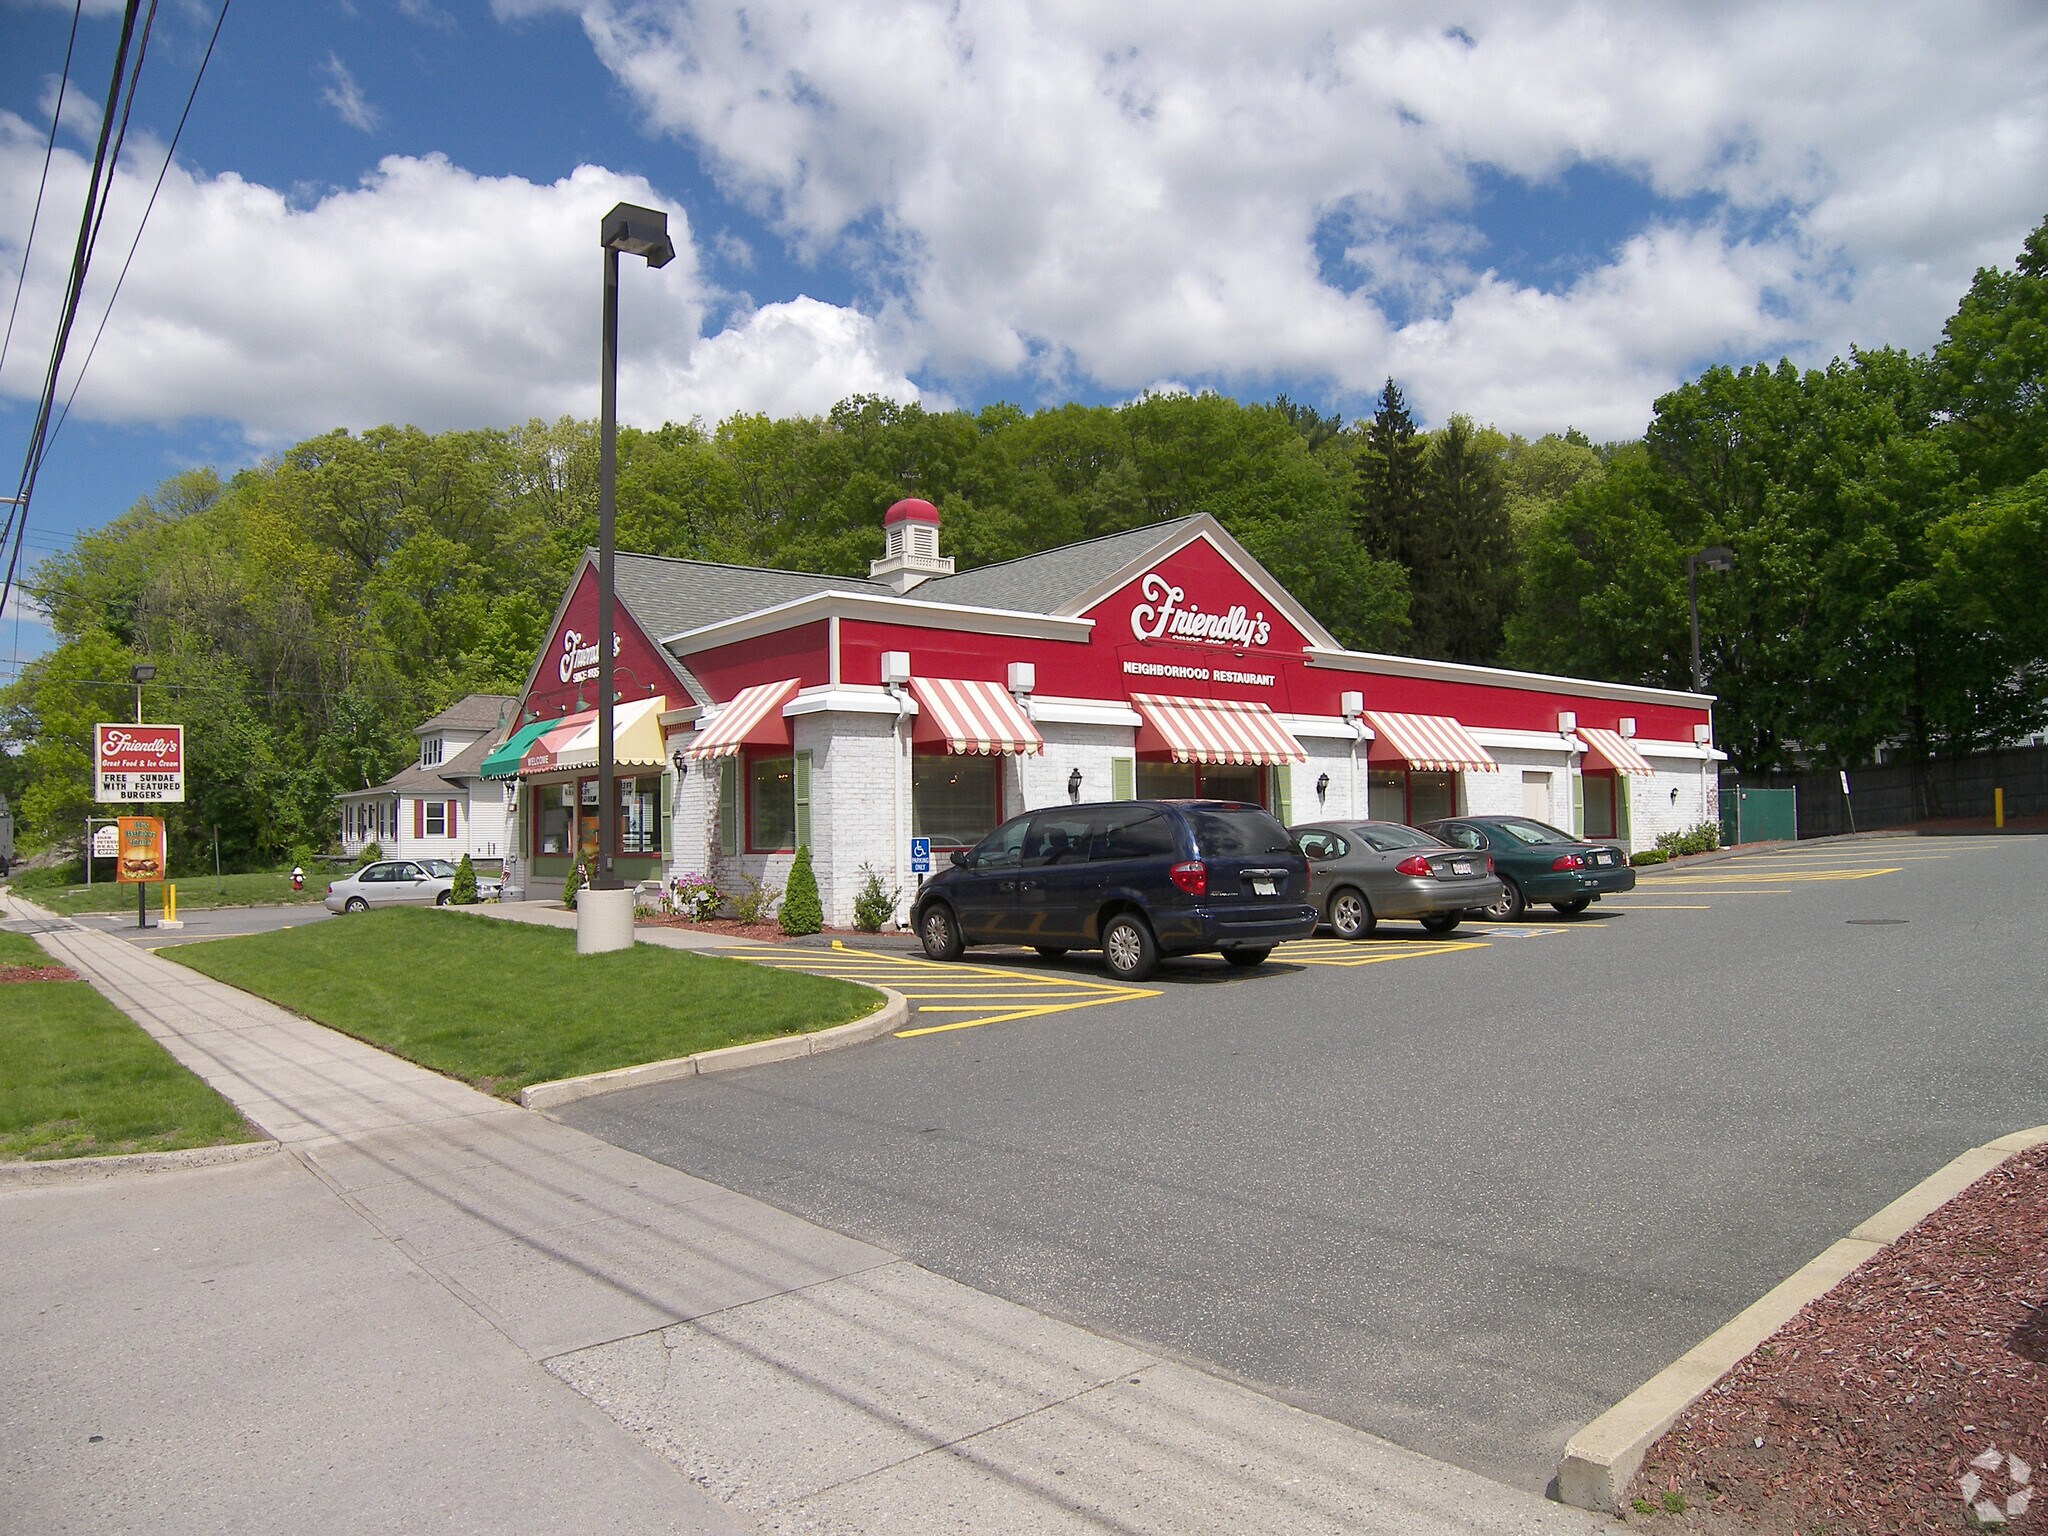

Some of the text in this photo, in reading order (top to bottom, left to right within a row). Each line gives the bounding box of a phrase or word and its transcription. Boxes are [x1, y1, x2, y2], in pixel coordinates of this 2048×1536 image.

[1131, 574, 1271, 656] Friendly's
[559, 629, 621, 683] Friend's
[1123, 661, 1275, 686] NEIGHBORHOOD RESTAURANT
[102, 730, 178, 758] Friendly's
[102, 759, 179, 767] Great Food & Ice Cream
[527, 755, 549, 766] WELCOME
[104, 774, 175, 782] FREE SUNDAE
[103, 782, 180, 791] WITH FEATURED
[121, 791, 162, 799] BURGERS
[125, 830, 156, 839] Burger
